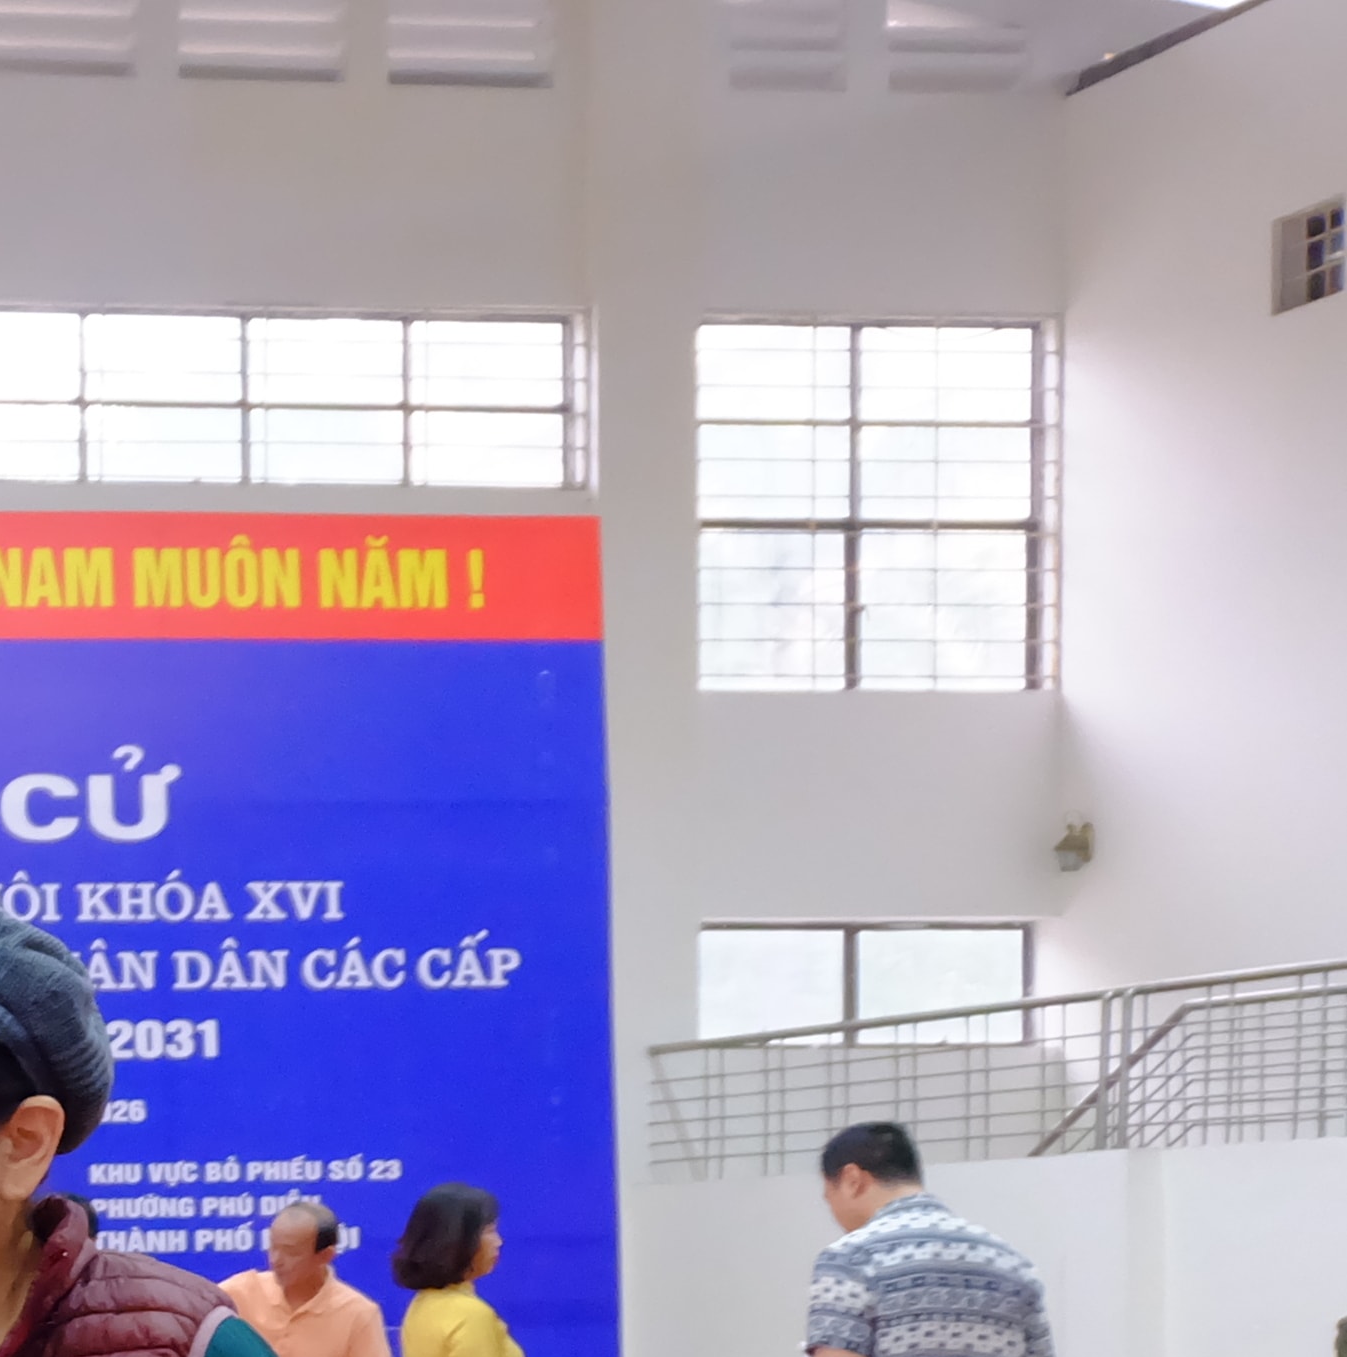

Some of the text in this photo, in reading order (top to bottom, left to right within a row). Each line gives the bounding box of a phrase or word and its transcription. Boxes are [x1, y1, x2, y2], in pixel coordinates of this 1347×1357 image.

[133, 535, 301, 609] MUÔN
[319, 537, 447, 608] NĂM
[469, 549, 484, 608] !
[0, 744, 181, 842] CỬ
[76, 869, 231, 921] KHÓA
[246, 881, 343, 920] XVI
[173, 938, 288, 989] DÂN
[303, 937, 405, 989] CÁC
[418, 929, 520, 988] CẤP
[105, 1019, 218, 1059] 2031
[89, 1154, 401, 1187] KHU VỰC BỎ PHIẾU SỐ 23
[201, 1193, 254, 1217] PHÚ
[195, 1221, 253, 1252] PHỐ
